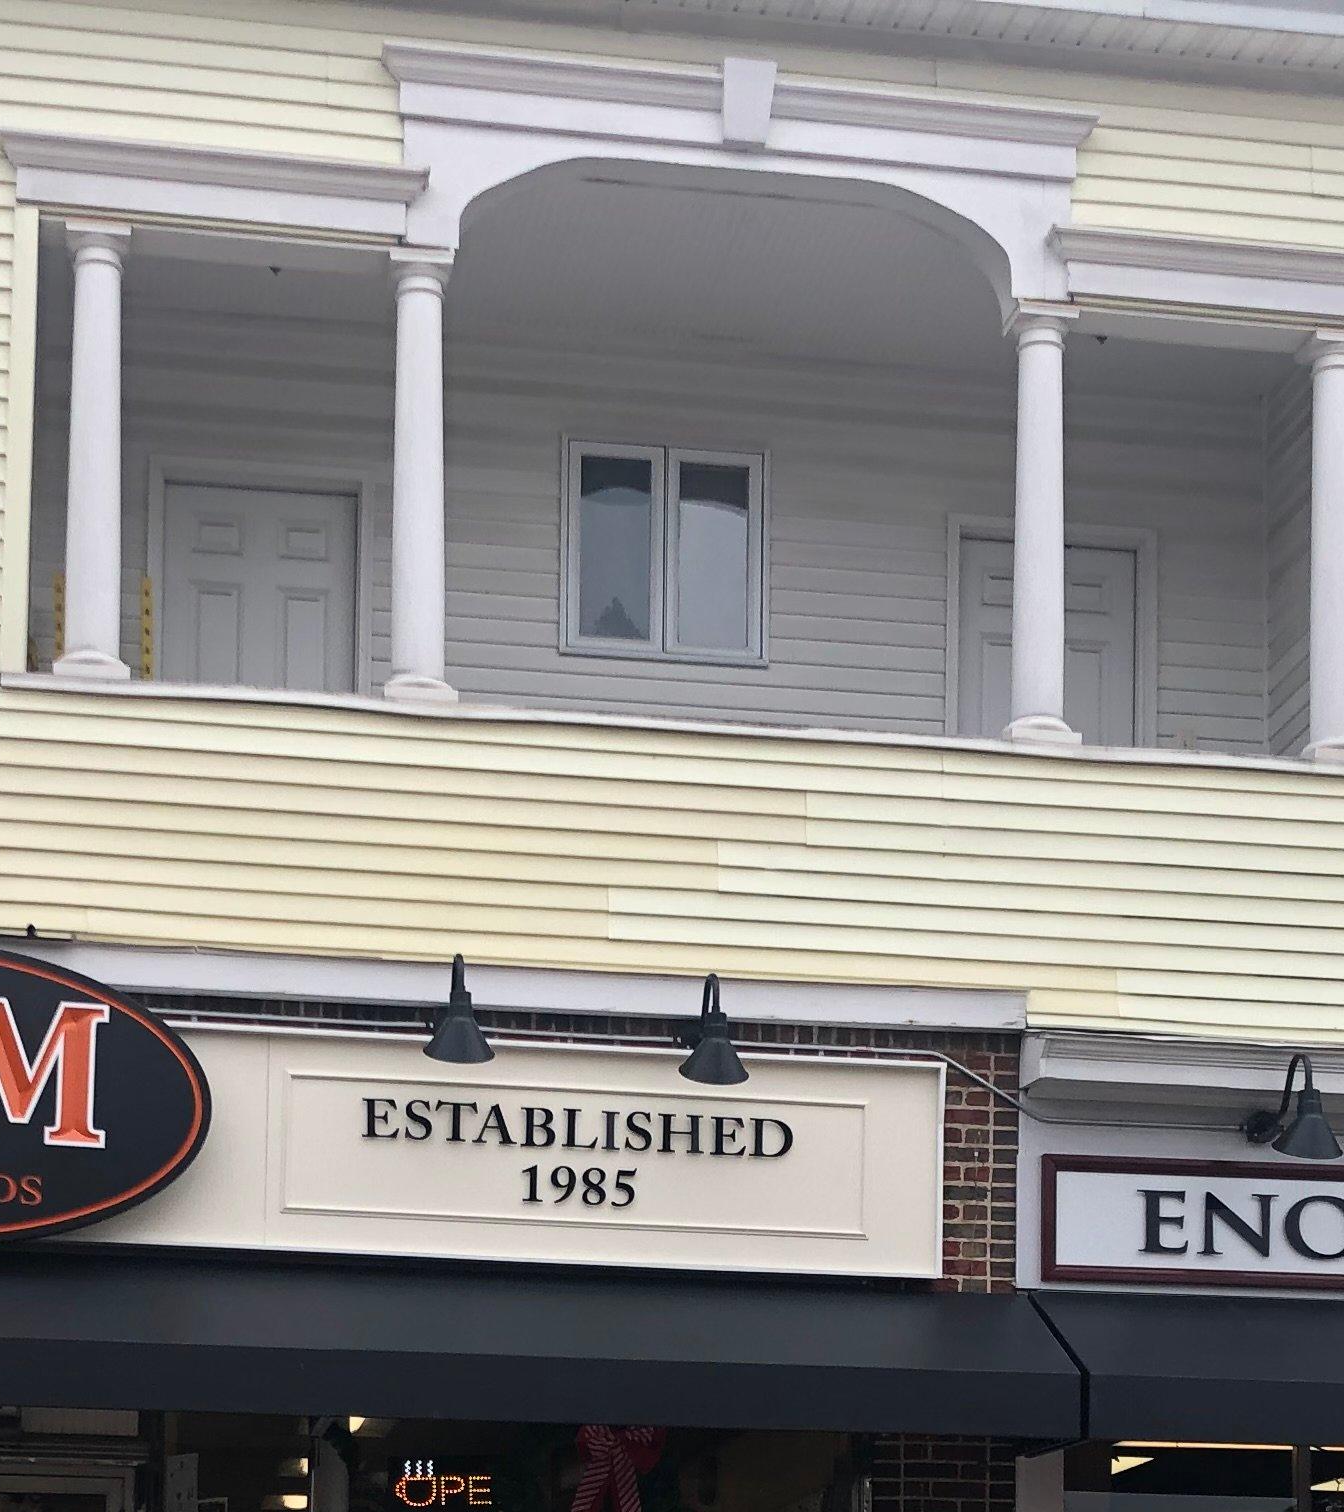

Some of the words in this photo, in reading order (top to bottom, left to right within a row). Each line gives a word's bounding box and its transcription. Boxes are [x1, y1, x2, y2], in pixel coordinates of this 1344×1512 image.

[361, 1097, 795, 1159] ESTABLISHED
[522, 1164, 638, 1208] 1985
[395, 1475, 493, 1507] OPE
